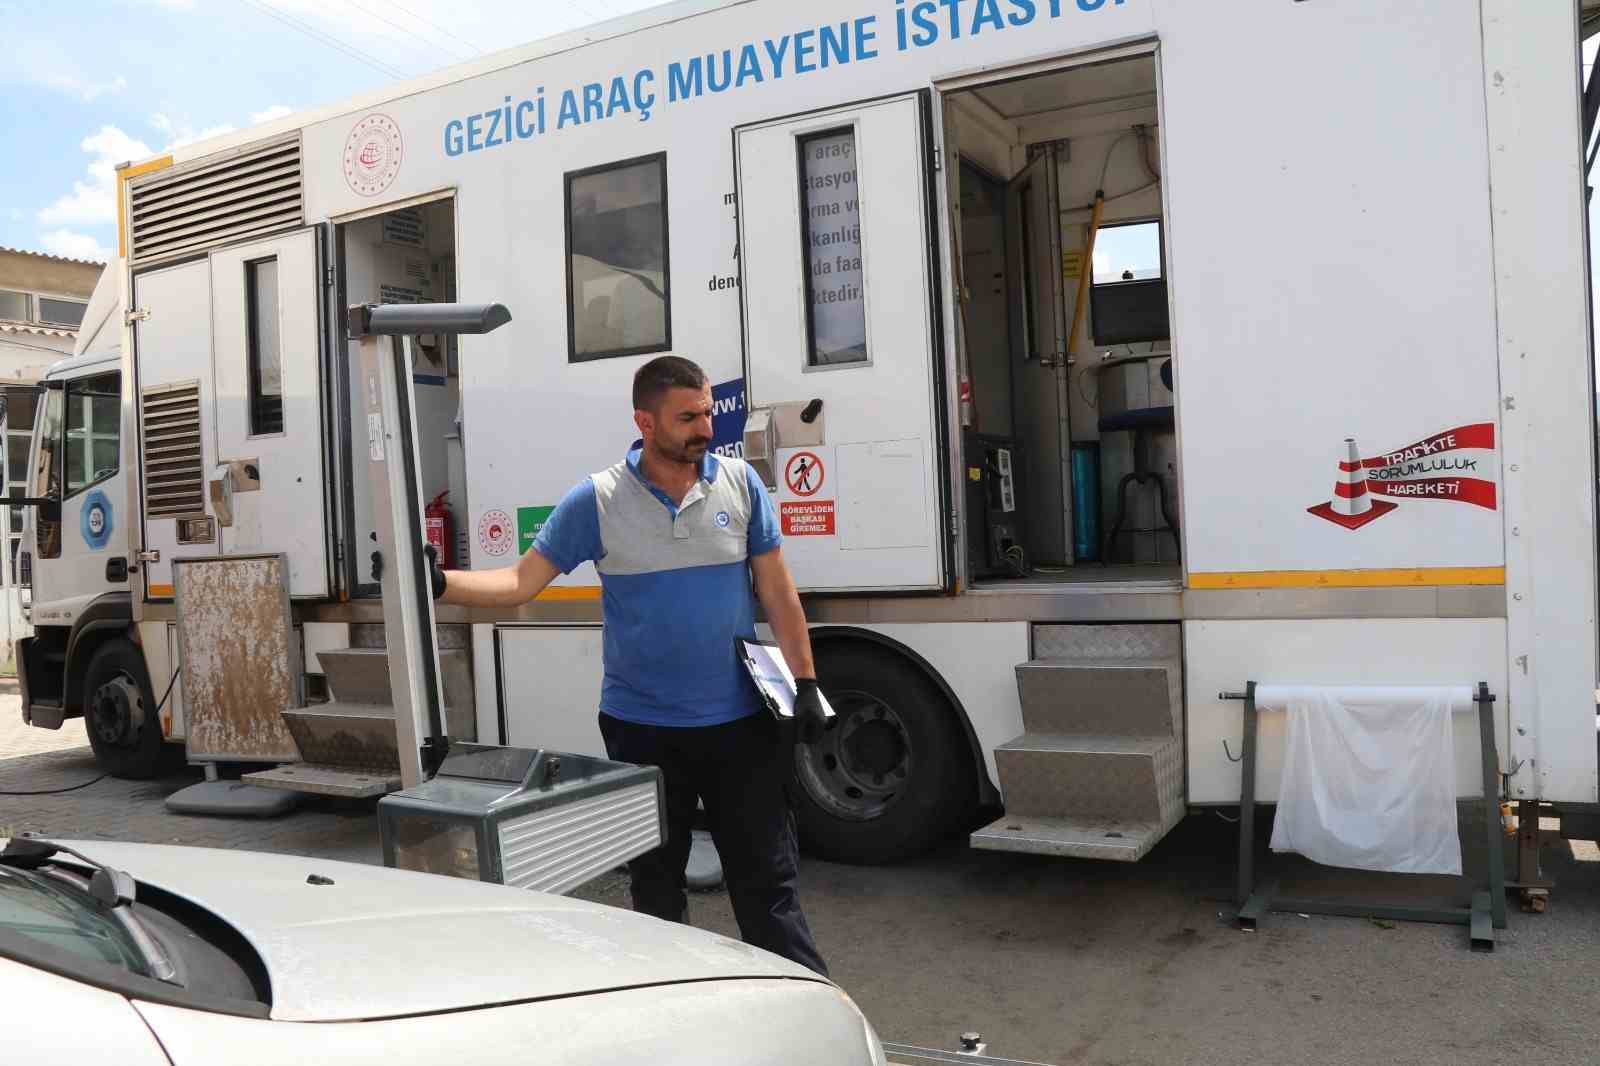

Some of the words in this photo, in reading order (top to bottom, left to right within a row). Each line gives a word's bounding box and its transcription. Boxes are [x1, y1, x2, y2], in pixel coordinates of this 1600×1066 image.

[444, 86, 546, 157] GEZİCİ
[556, 69, 655, 130] ARAÇ
[667, 15, 879, 103] MUAYENE
[895, 0, 1126, 51] İSTAS
[1382, 434, 1457, 466] TRAFİKTE
[1368, 457, 1478, 480] SORUMLULUK
[1386, 480, 1460, 495] HAREKETİ
